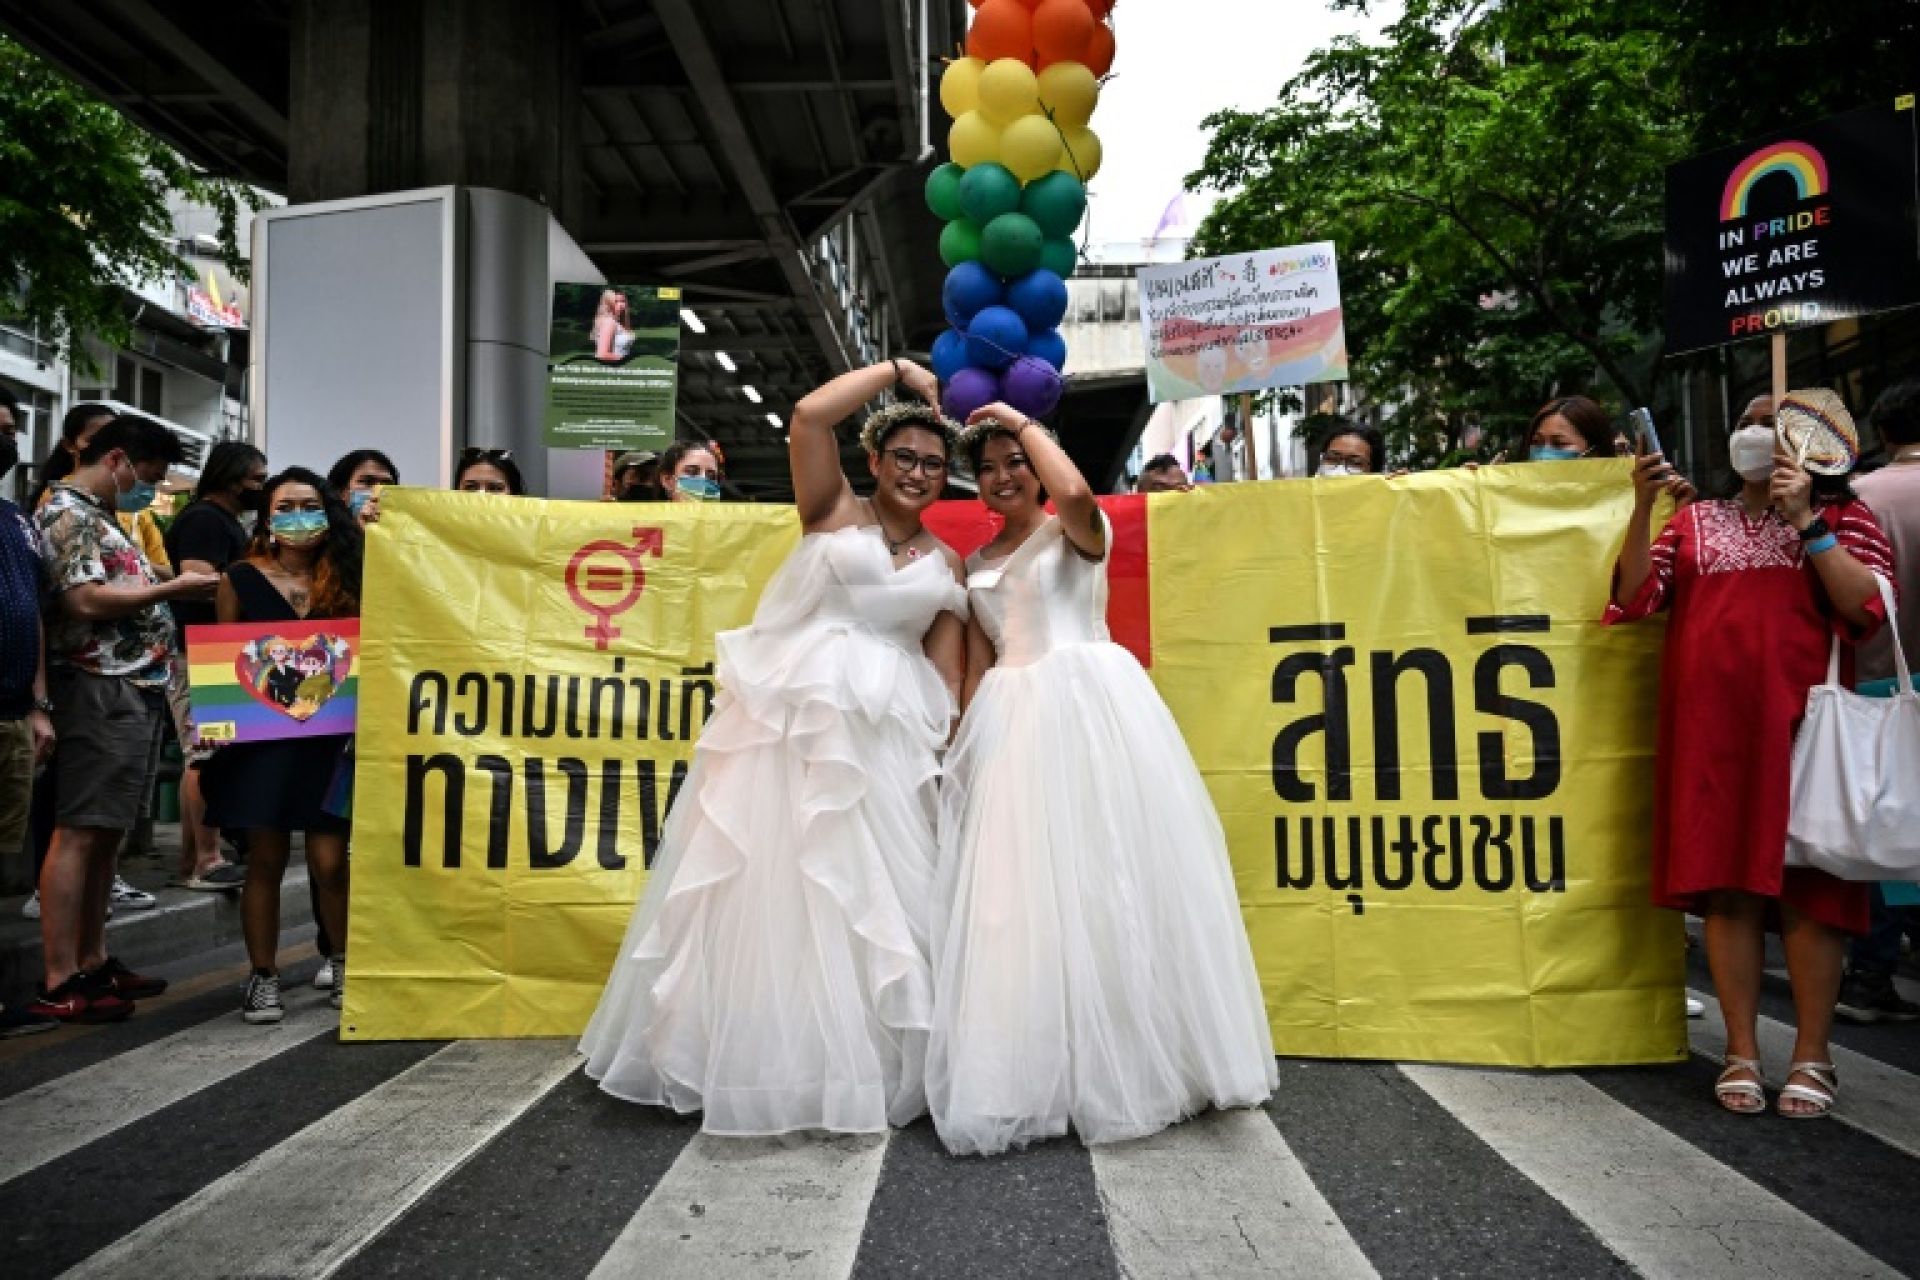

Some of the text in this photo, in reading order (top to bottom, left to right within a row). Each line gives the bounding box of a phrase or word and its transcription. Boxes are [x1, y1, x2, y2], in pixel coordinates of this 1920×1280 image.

[1719, 207, 1831, 250] IN PRIDE
[1722, 239, 1818, 278] WE ARE
[1725, 269, 1825, 308] ALWAYS
[1731, 302, 1821, 336] PROUD
[1268, 614, 1562, 803] สิทธิ
[1274, 813, 1567, 916] มนุษยชน
